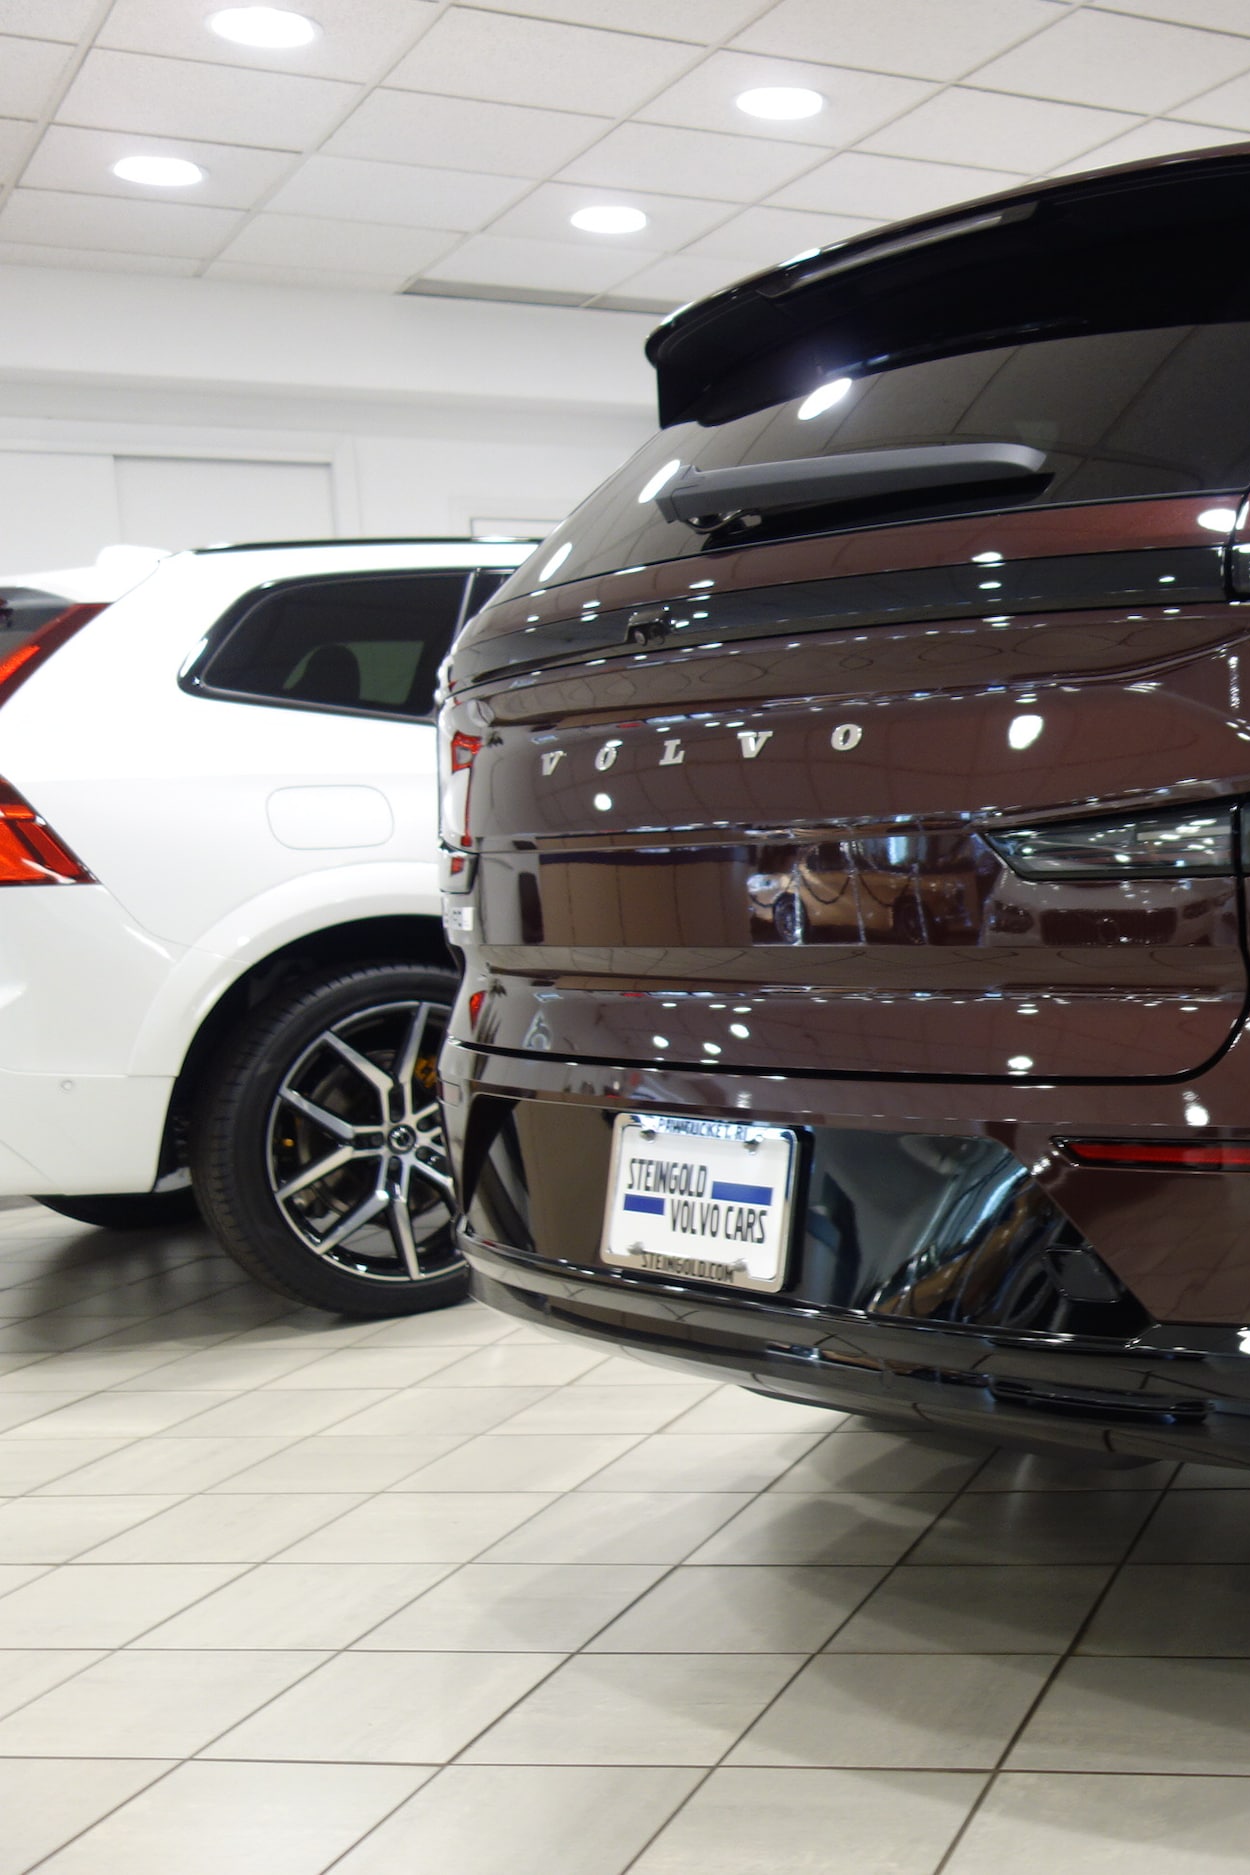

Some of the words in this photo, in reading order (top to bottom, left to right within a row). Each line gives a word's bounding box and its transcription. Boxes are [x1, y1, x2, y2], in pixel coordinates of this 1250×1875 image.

[540, 723, 863, 776] VOLVO
[627, 1158, 708, 1198] STEINGOLD
[671, 1200, 720, 1238] VOLVO
[725, 1206, 768, 1243] CARS
[641, 1252, 734, 1283] STEINGOLD.COM
